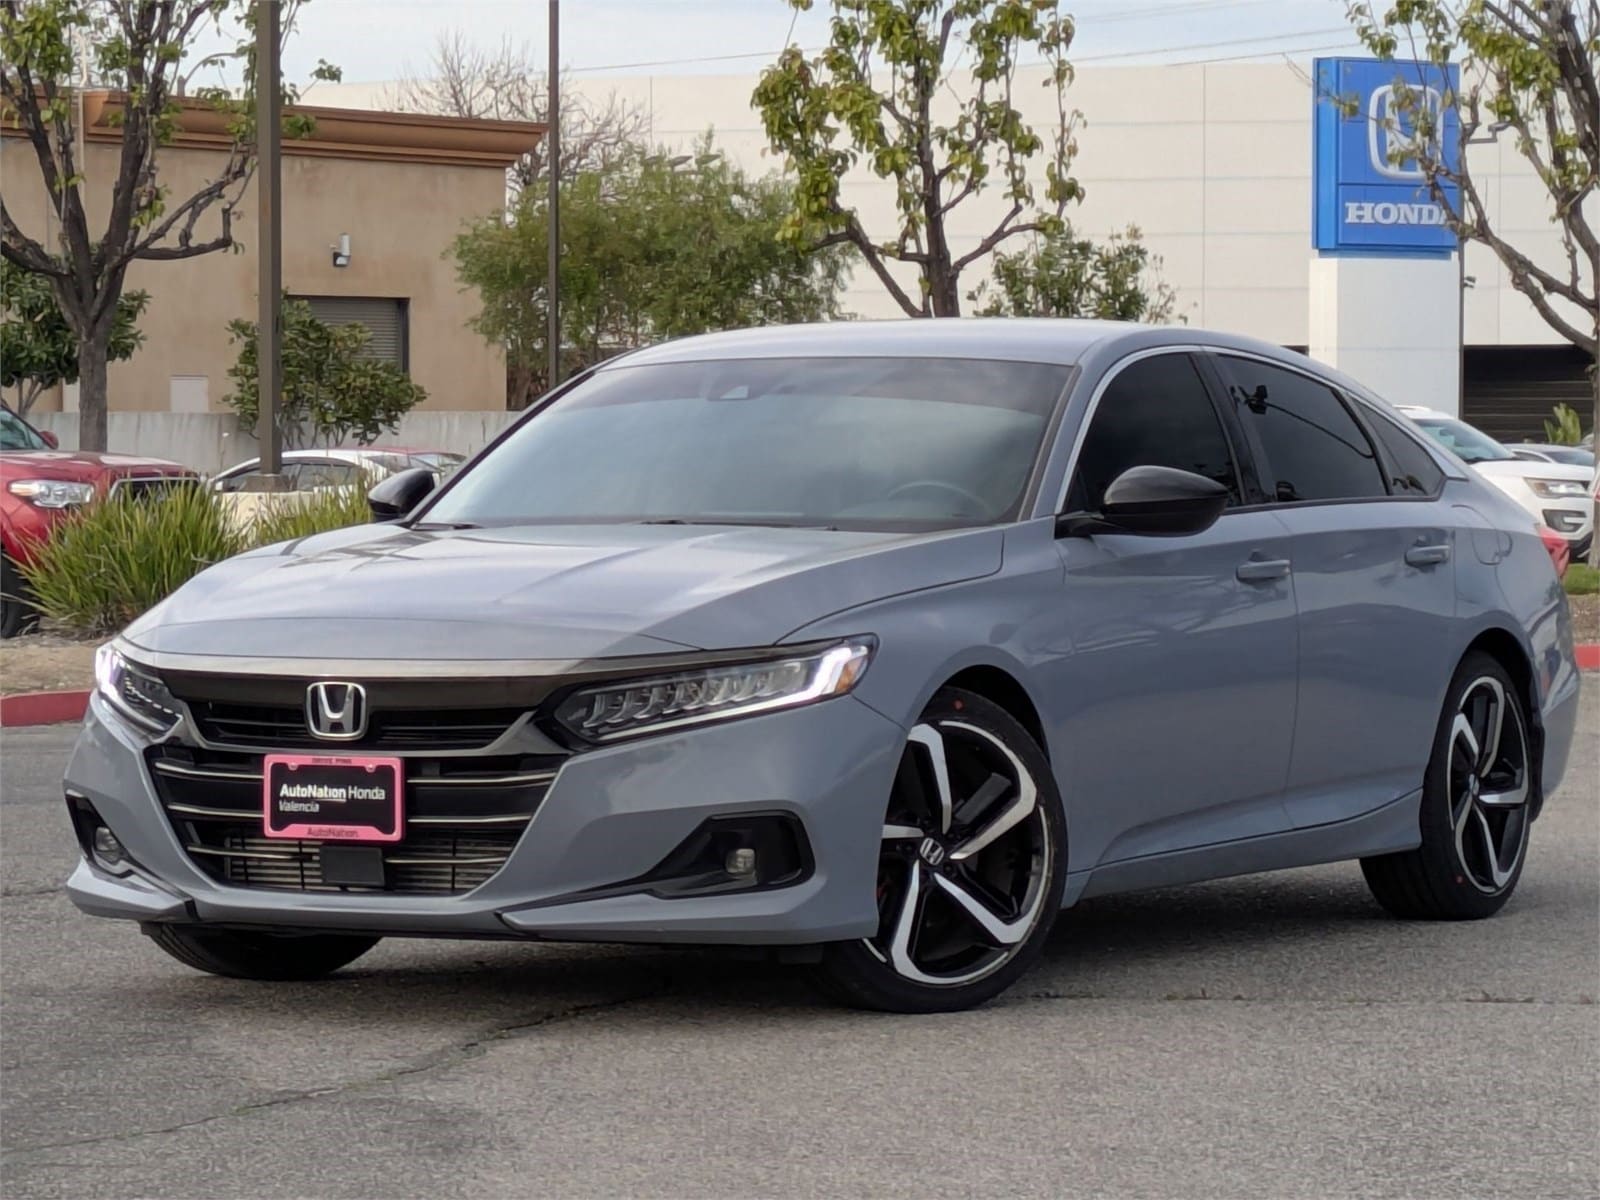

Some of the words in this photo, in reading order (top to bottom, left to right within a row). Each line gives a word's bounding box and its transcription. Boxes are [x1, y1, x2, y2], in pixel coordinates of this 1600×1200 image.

[280, 783, 346, 799] AutoNation
[348, 785, 386, 800] Honda
[279, 800, 320, 813] Valencia
